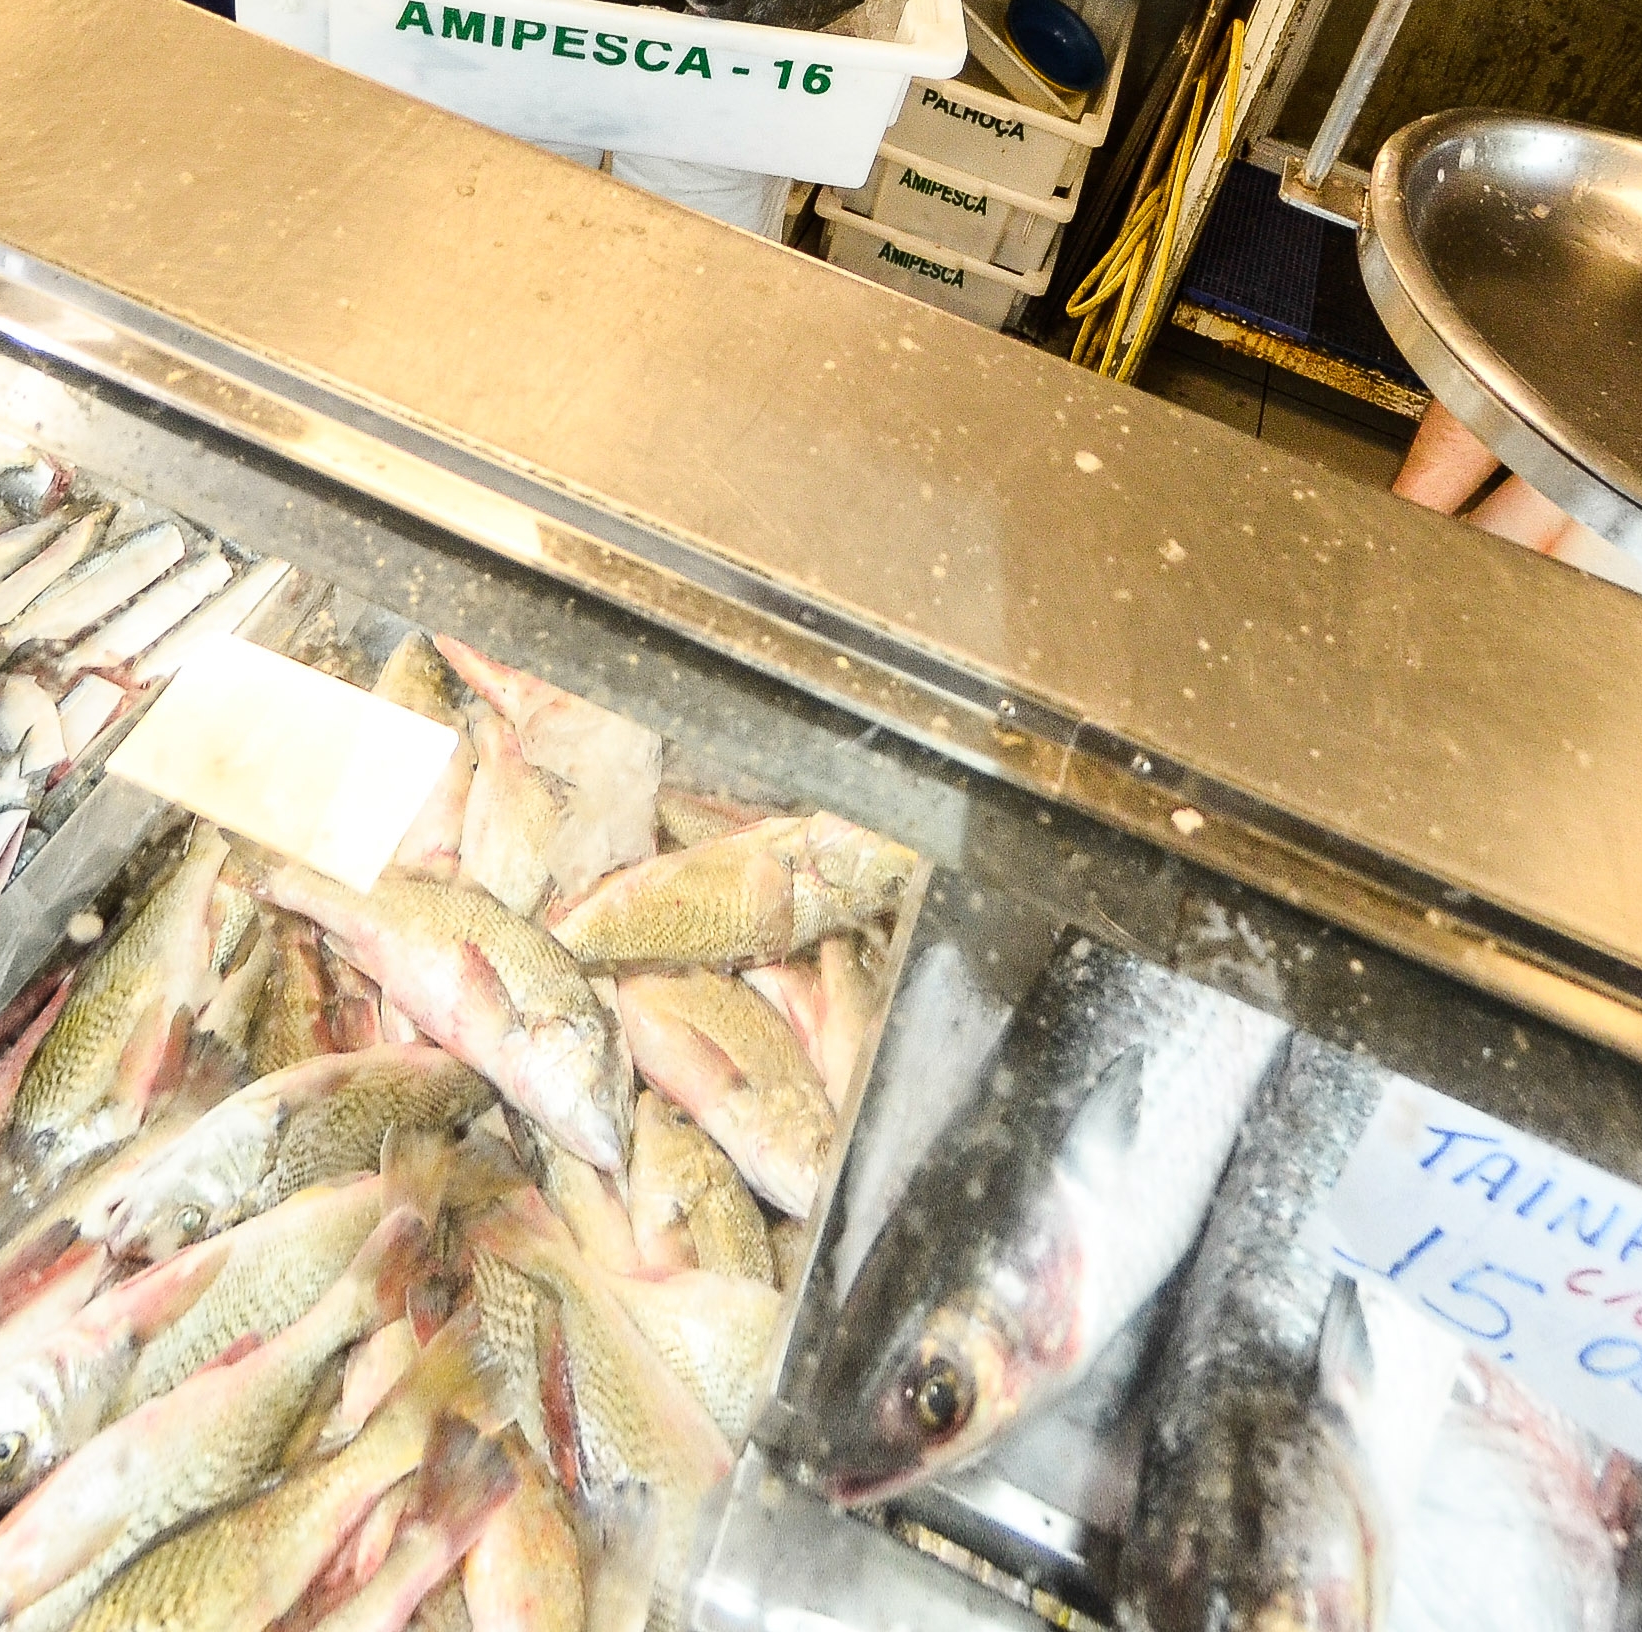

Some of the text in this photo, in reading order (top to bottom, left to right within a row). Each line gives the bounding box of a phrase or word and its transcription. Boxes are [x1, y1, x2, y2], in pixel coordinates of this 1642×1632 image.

[395, 0, 712, 79] AMIPESCA
[773, 58, 834, 95] 16
[921, 87, 1025, 142] PALHOÇA
[898, 167, 988, 216] AMIPESCA
[877, 240, 966, 289] AMIPESCA
